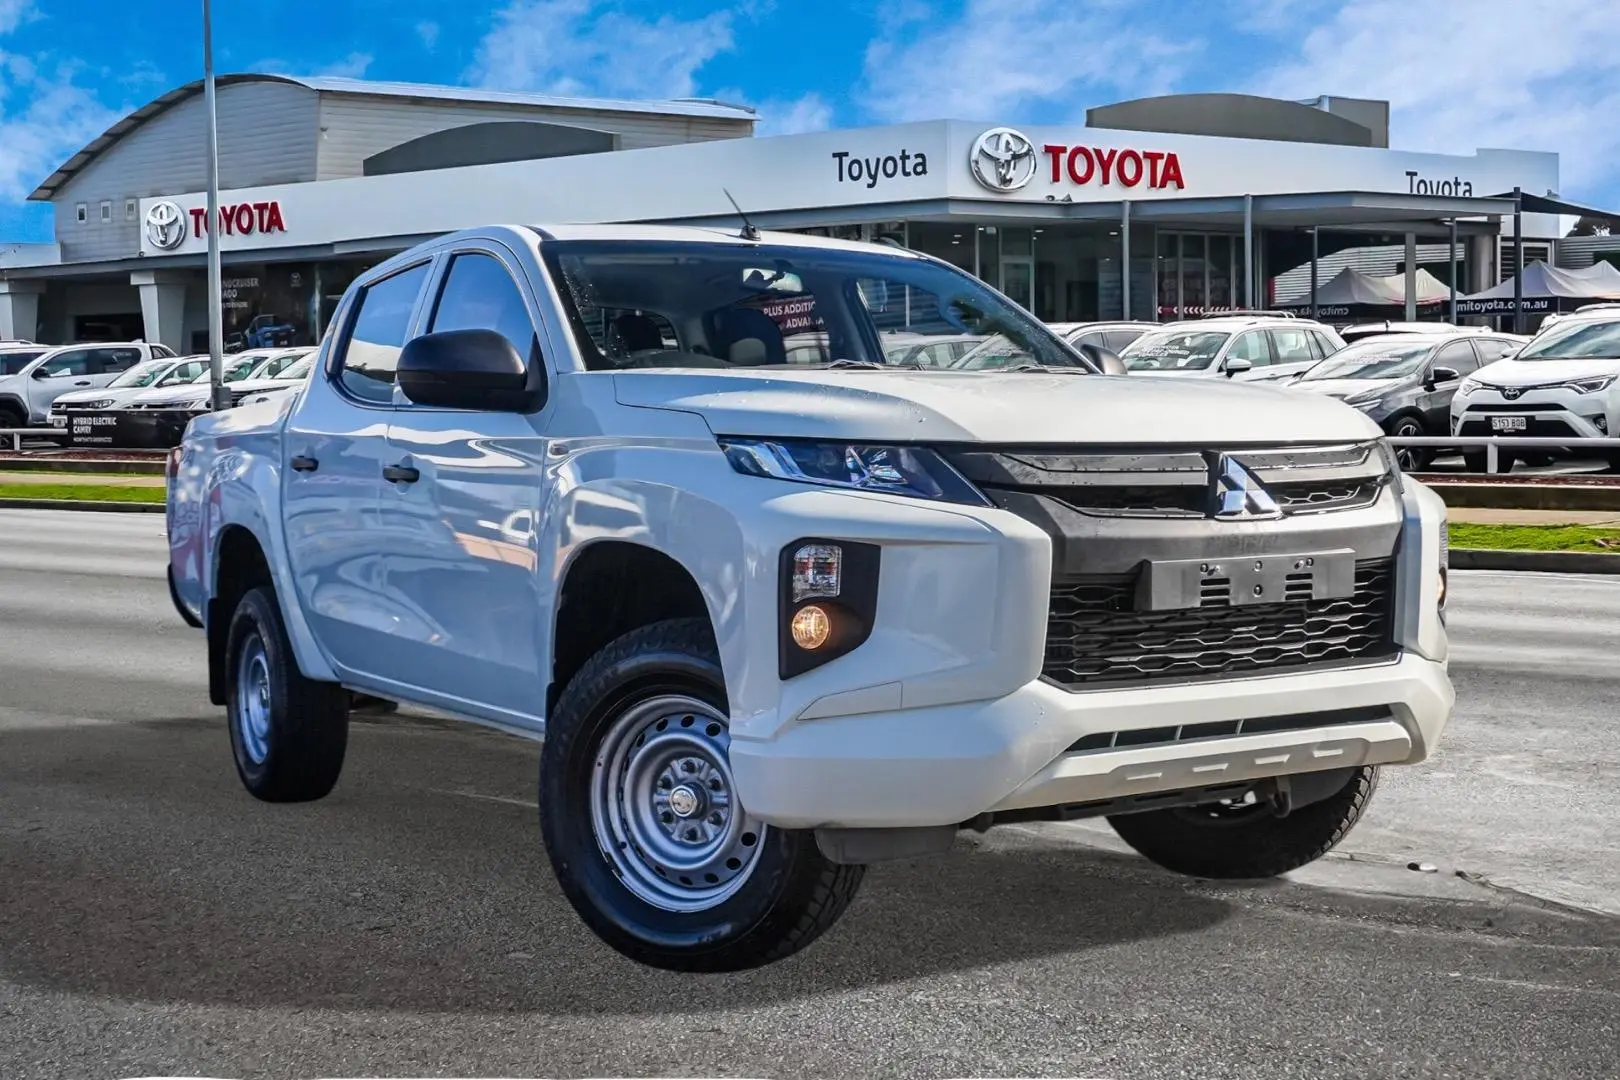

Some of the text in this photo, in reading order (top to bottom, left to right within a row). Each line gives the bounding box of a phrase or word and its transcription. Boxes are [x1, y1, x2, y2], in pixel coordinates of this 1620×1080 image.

[832, 149, 928, 188] Toyota
[1044, 144, 1185, 189] TOYOTA
[1457, 300, 1548, 313] mitoyota.cm.au
